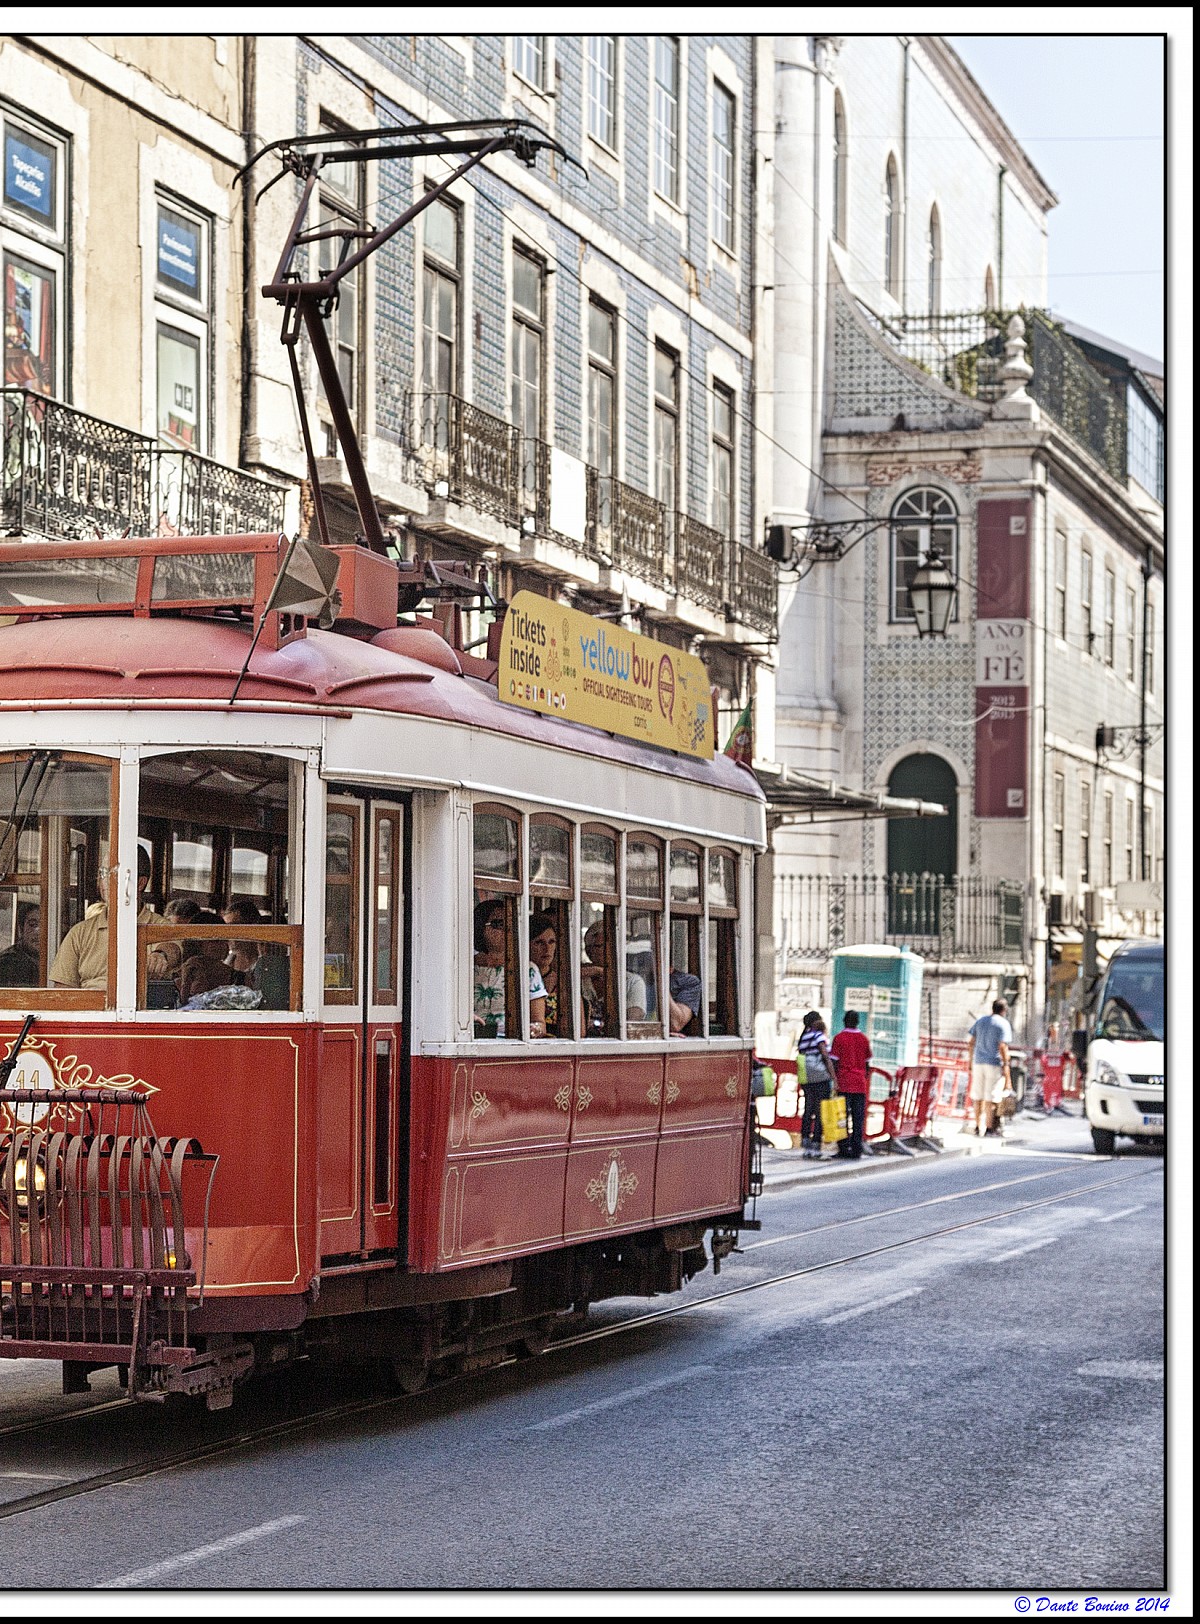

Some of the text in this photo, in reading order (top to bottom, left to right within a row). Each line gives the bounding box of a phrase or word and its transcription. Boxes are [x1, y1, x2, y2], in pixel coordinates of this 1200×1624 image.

[510, 607, 547, 647] Tickets
[983, 624, 1024, 639] ANO
[510, 640, 541, 677] inside
[580, 628, 655, 689] yellow bus
[984, 649, 1025, 681] FÉ
[582, 677, 606, 698] OFFICIAL
[605, 684, 638, 708] SIGHTSEEING
[637, 695, 653, 713] TOURS
[990, 694, 1016, 706] 2012
